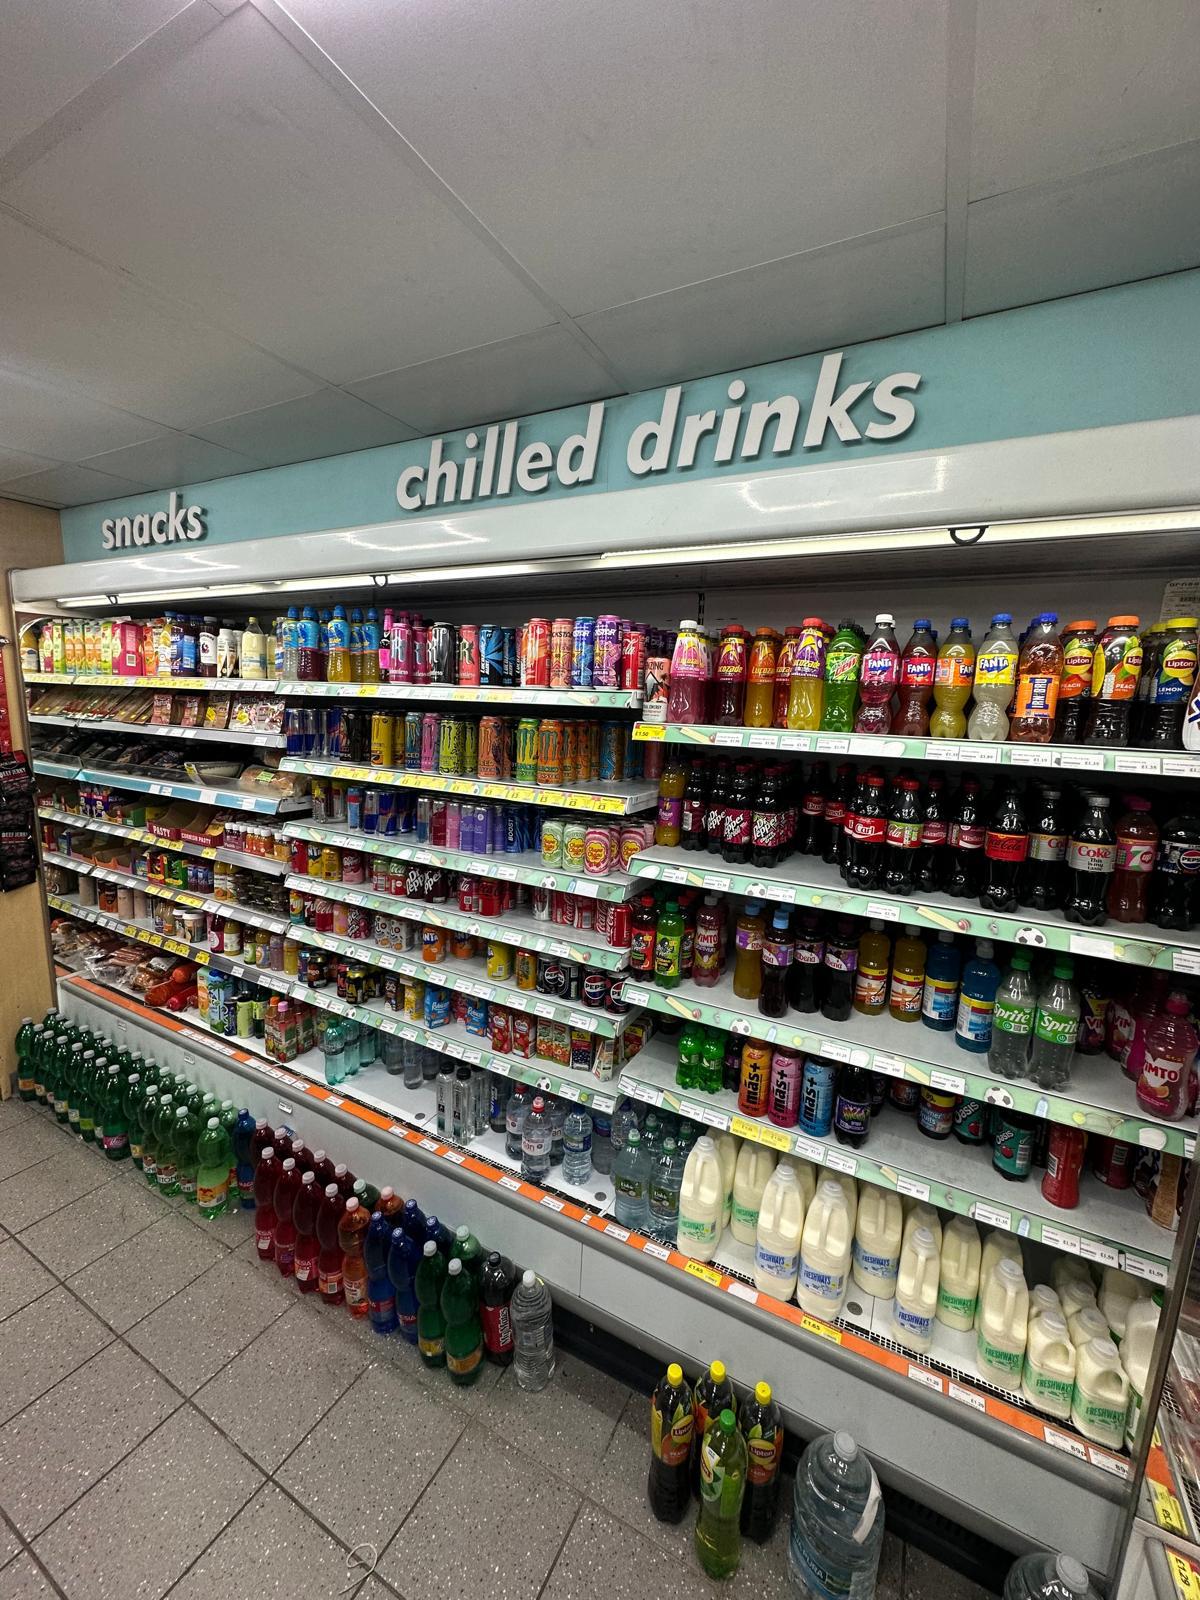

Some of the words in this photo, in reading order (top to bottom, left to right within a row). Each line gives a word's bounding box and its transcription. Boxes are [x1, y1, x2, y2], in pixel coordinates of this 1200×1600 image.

[395, 402, 606, 511] chilled
[627, 352, 923, 476] drinks
[101, 491, 207, 550] snacks
[960, 665, 974, 674] FAN
[980, 656, 1009, 671] FANTA
[153, 826, 170, 837] PASTY
[198, 836, 211, 844] PASTY
[1078, 846, 1110, 859] Coke
[994, 1002, 1029, 1023] Sprite
[688, 1264, 703, 1274] £1.65
[1149, 1268, 1164, 1278] £1.59
[803, 1270, 831, 1285] FRESHWAYS
[803, 1319, 820, 1331] £1.65
[898, 1311, 930, 1327] FRESHWAYS
[985, 1347, 1020, 1361] FRESHWAYS
[1086, 1407, 1125, 1421] FRESHWAYS
